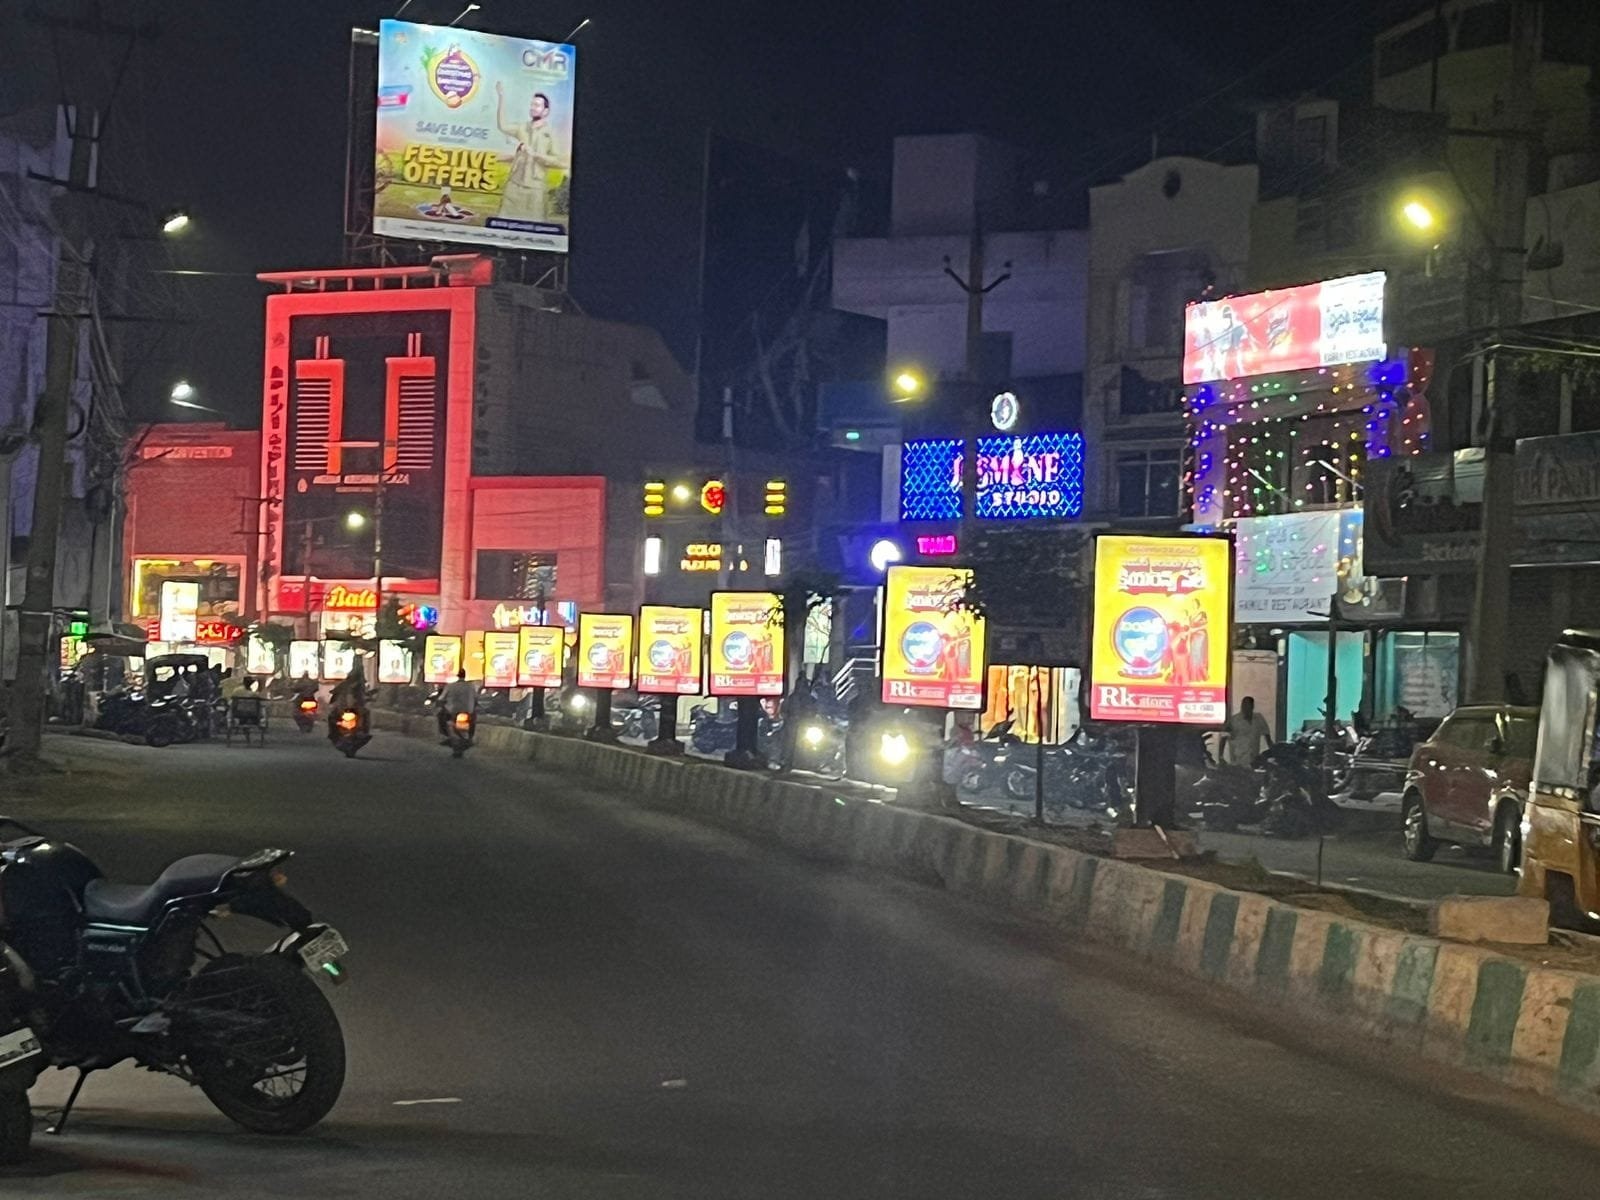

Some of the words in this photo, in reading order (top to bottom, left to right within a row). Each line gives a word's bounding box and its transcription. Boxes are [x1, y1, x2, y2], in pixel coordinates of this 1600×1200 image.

[522, 49, 567, 71] CMR
[416, 121, 448, 136] SAVE
[450, 125, 490, 140] MORE
[404, 144, 497, 170] FESTIVE
[404, 162, 499, 190] OFFERS
[949, 453, 1060, 488] JSMINE
[714, 674, 734, 687] Rk
[889, 681, 917, 697] Rk
[1099, 686, 1137, 707] Rk
